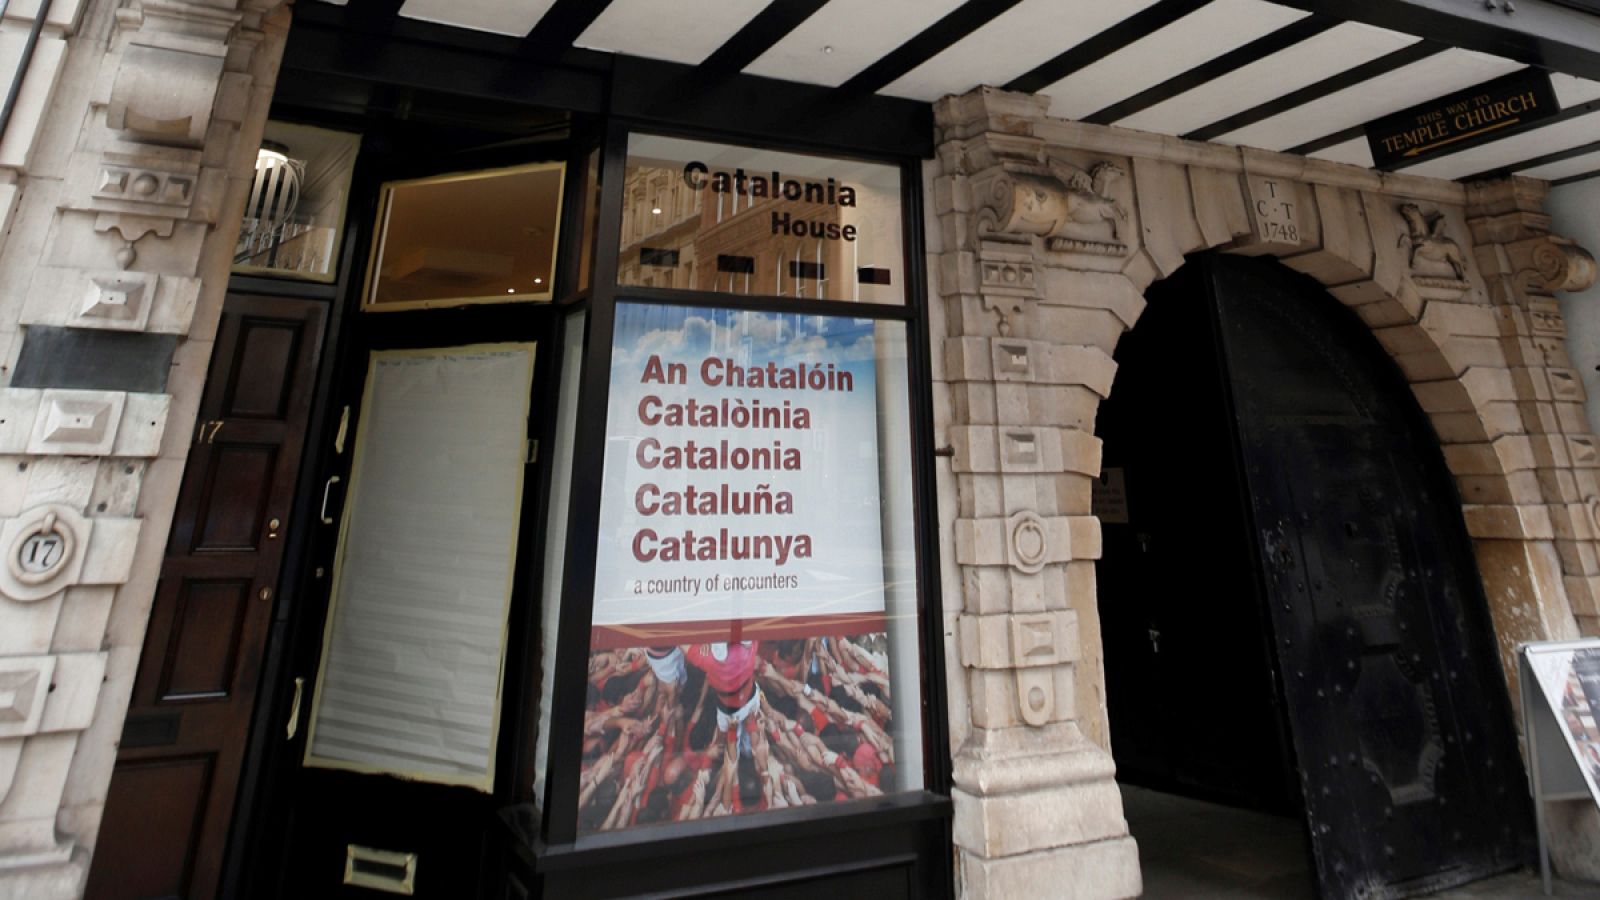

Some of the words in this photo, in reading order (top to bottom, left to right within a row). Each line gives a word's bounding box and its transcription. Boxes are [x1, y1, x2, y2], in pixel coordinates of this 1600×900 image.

[1382, 121, 1449, 153] TEMPLE
[1455, 91, 1538, 131] CHURCH
[1416, 110, 1443, 126] THIS
[1447, 100, 1470, 115] WAY
[1472, 94, 1491, 108] TO
[683, 161, 856, 208] Catalonia
[1264, 180, 1277, 198] T
[771, 211, 857, 242] House
[640, 354, 688, 385] An
[700, 356, 854, 392] Chatalóin
[638, 395, 811, 430] Catalòinia
[198, 420, 225, 444] 17
[635, 437, 801, 471] Catalonia
[635, 483, 793, 516] Cataluña
[28, 540, 57, 567] 17
[632, 528, 812, 566] Catalunya
[634, 579, 642, 595] a
[647, 575, 701, 597] country
[705, 573, 720, 592] of
[723, 572, 798, 592] encounters
